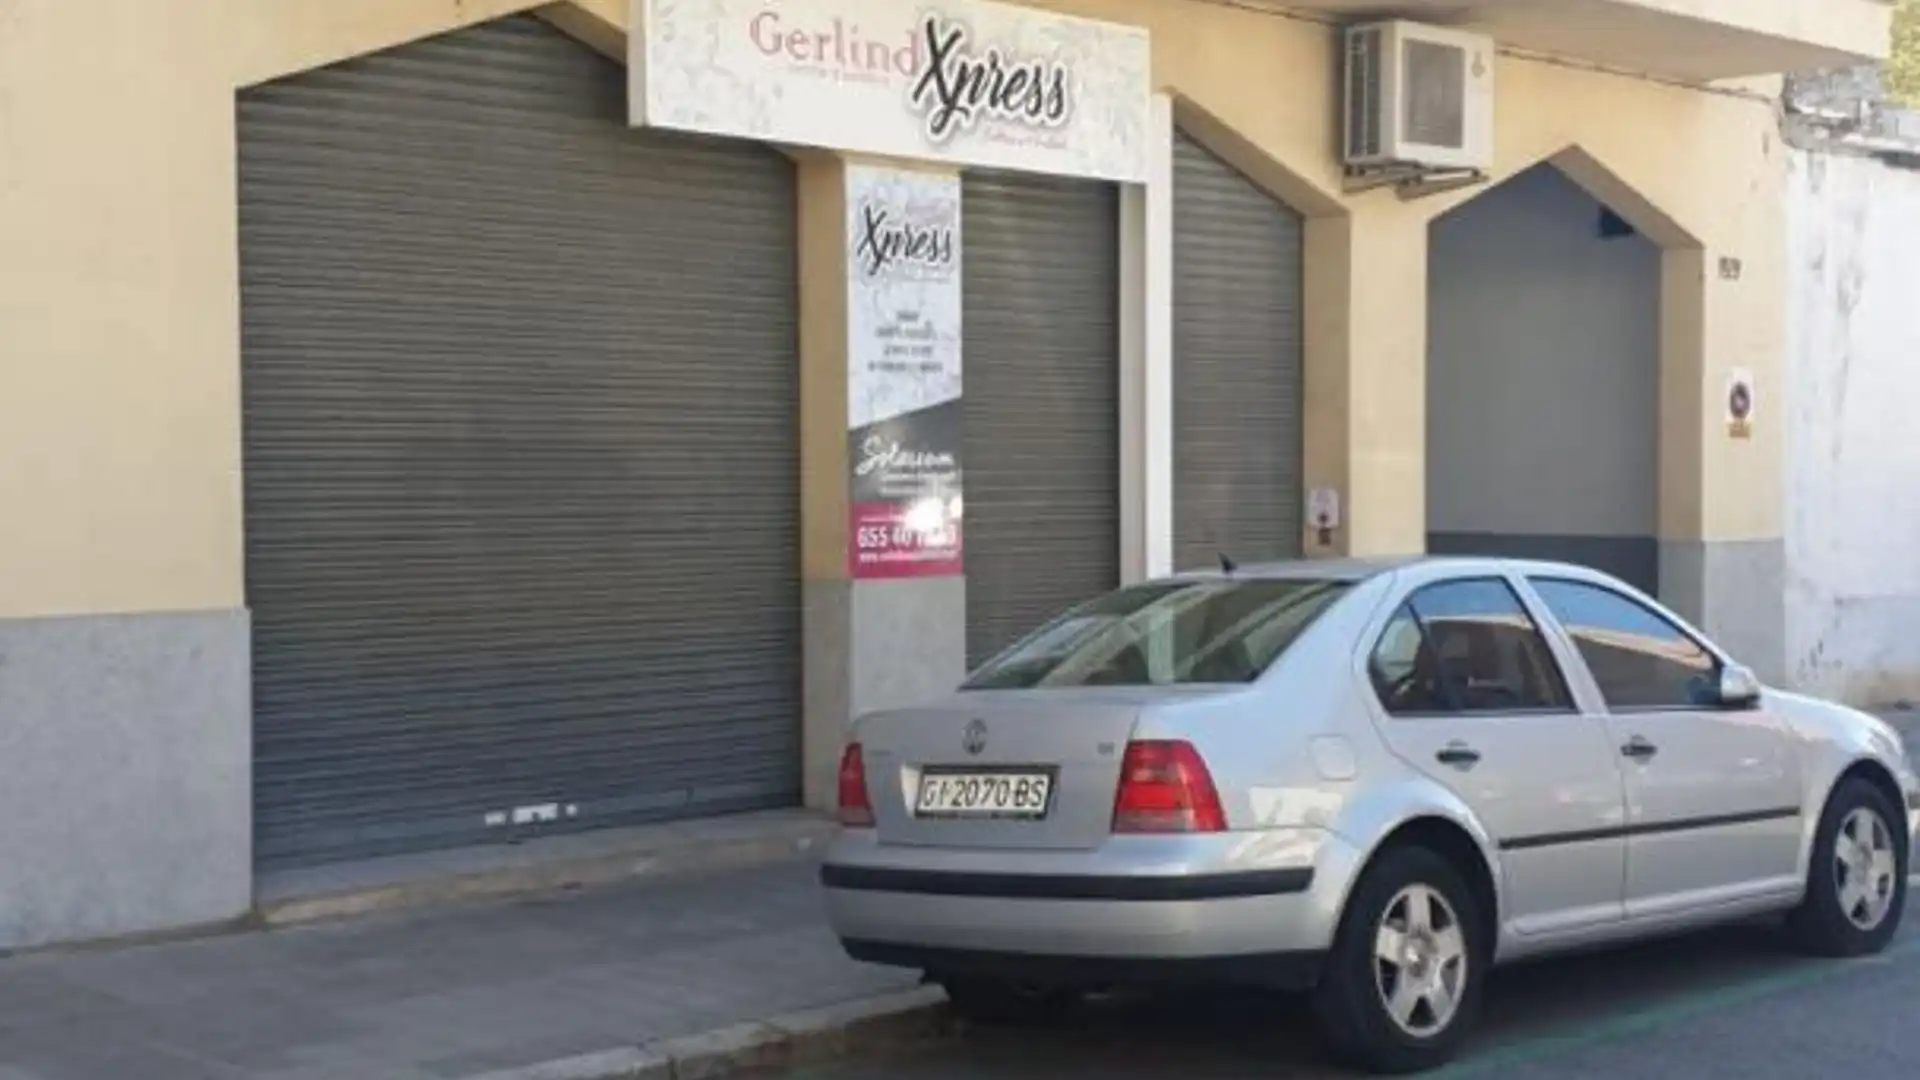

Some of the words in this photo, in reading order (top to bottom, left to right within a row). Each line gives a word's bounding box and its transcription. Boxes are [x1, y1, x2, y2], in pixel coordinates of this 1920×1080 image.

[750, 11, 922, 78] Gerlind
[912, 18, 1066, 134] Xpress
[857, 205, 951, 276] Xpress
